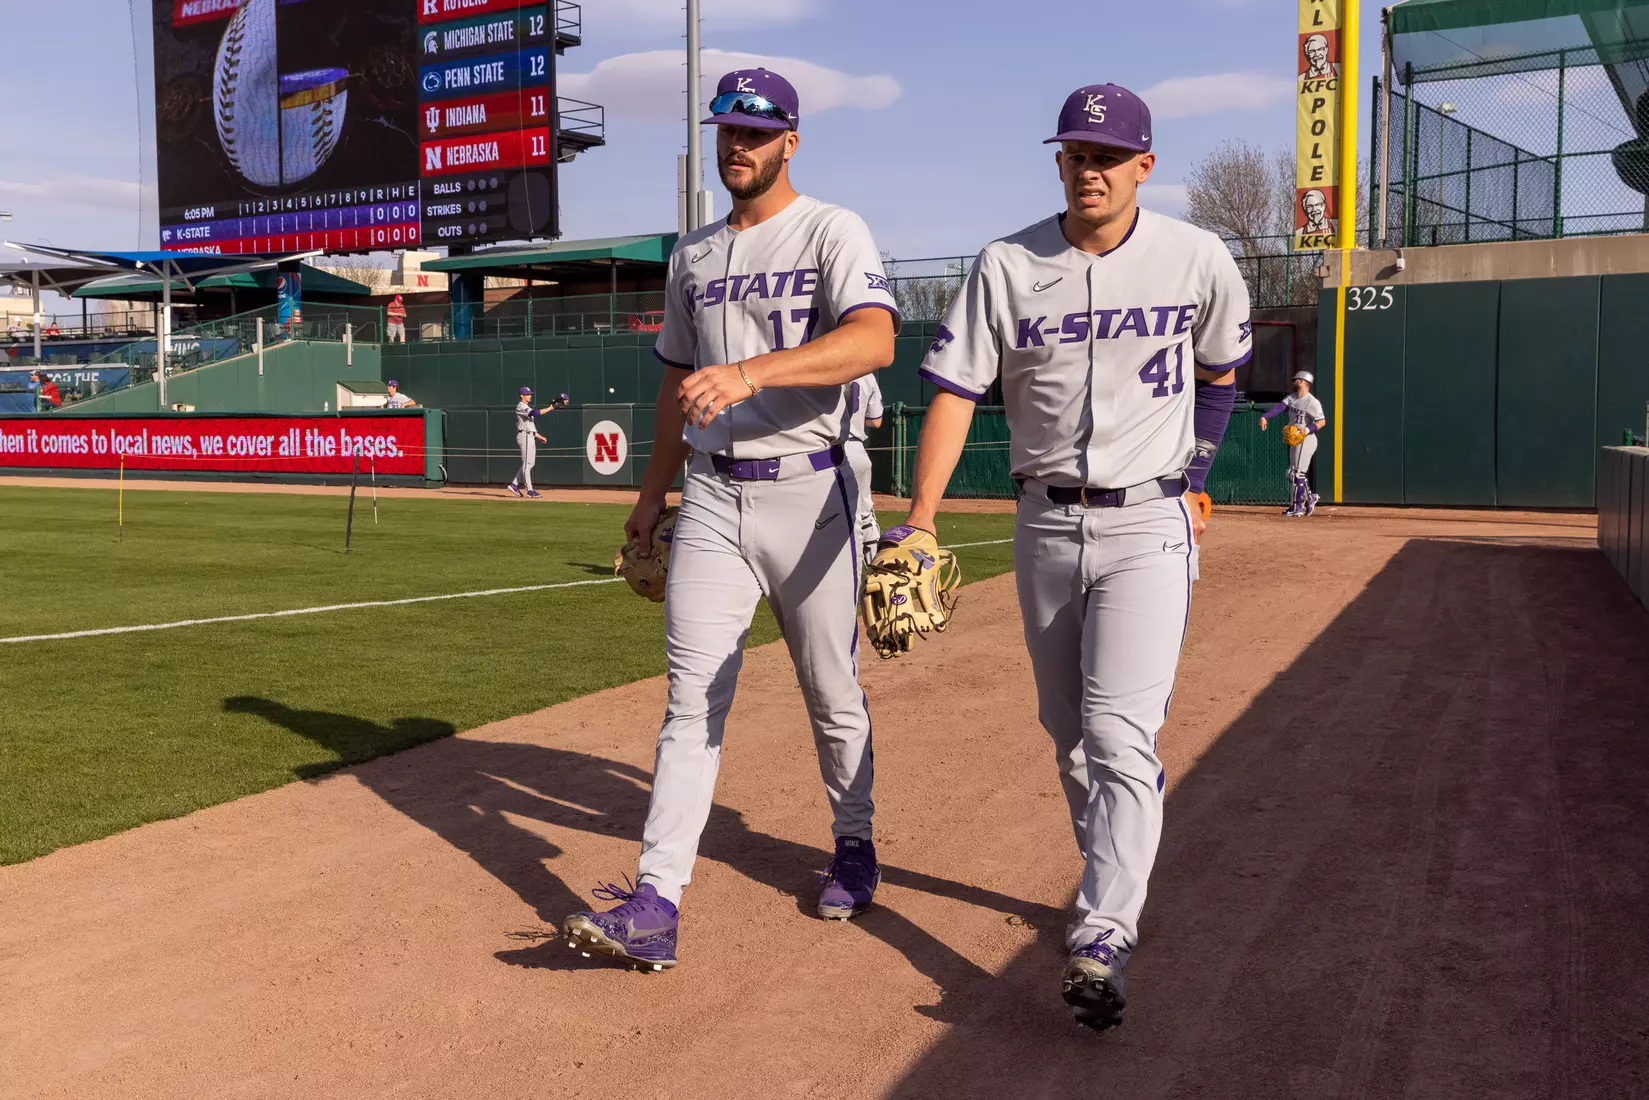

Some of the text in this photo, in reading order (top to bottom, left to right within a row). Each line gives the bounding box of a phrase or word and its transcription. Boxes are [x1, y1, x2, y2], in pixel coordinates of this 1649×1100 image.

[444, 20, 514, 50] MICHIGAN STATE
[529, 15, 544, 36] 12
[445, 61, 504, 89] PENN STATE
[530, 55, 545, 76] 12
[1300, 78, 1338, 94] KFC
[445, 104, 487, 128] INDIANA
[531, 95, 545, 116] 11
[532, 136, 546, 156] 11
[1311, 98, 1325, 181] POLE
[446, 141, 499, 166] NEBRASKA
[434, 182, 461, 194] BALLS
[245, 185, 415, 213] 1 2 3 4 5 6 7 8 9 R H E
[184, 206, 214, 219] 6:05 PM
[377, 205, 416, 220] 0 0 0
[427, 204, 462, 216] STRIKES
[177, 226, 210, 240] K-STATE
[378, 227, 416, 242] 0 0 0
[438, 226, 462, 237] OUTS
[1300, 234, 1336, 248] KFC
[417, 275, 429, 287] N
[686, 269, 818, 312] K-STATE
[1348, 286, 1394, 311] 325
[767, 307, 819, 352] 17
[1015, 304, 1198, 349] K-STATE
[1139, 343, 1184, 398] 41
[0, 428, 403, 459] hen it comes to local news, we cover all the bases.
[594, 432, 620, 463] N
[844, 839, 860, 848] NIKE
